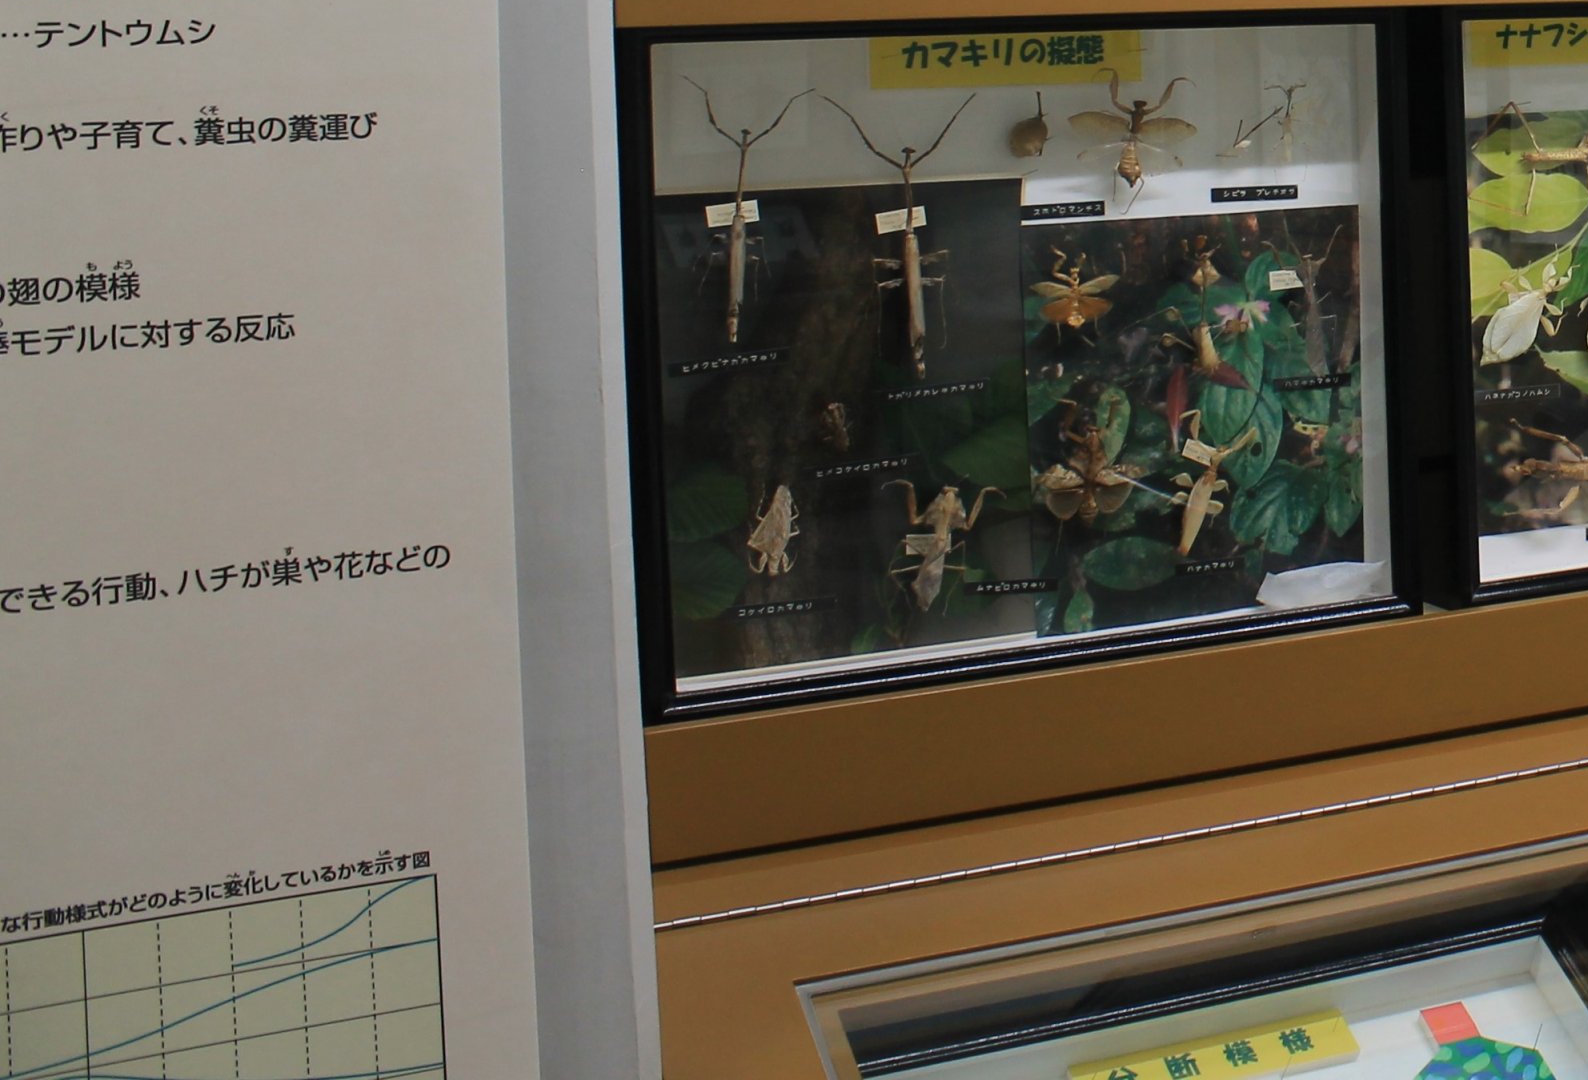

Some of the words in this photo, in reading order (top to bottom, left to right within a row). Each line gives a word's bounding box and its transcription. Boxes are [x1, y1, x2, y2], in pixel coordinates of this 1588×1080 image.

[902, 35, 1105, 69] カマキリの擬態
[0, 271, 141, 307] 翅の模様
[1, 851, 430, 933] な行動様式がどのように変化しているかを示す図
